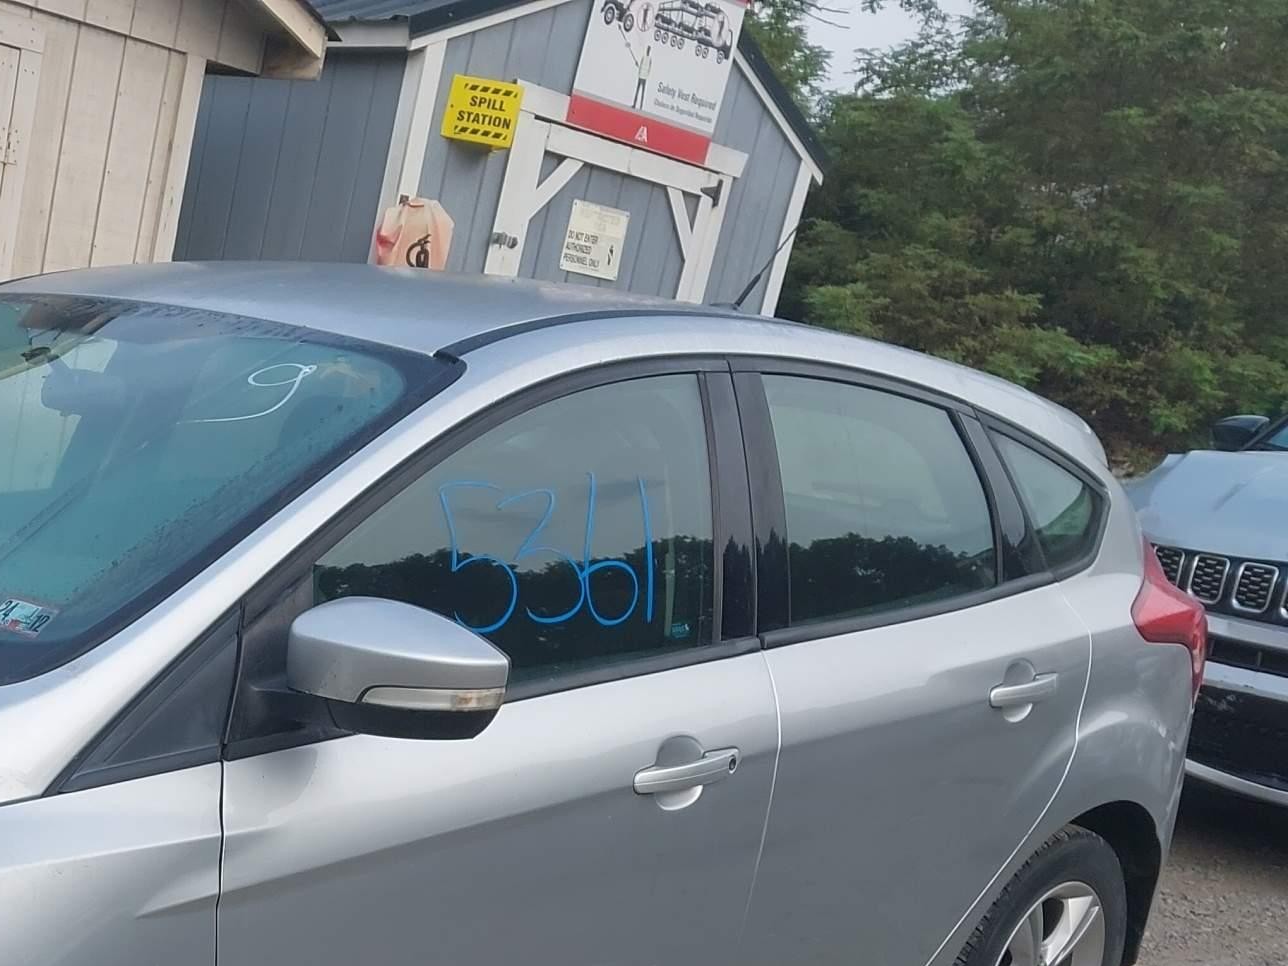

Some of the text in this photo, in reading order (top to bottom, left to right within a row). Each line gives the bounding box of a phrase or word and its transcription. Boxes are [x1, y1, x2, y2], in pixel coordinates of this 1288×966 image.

[469, 95, 506, 112] SPILL
[457, 110, 512, 130] STATION
[568, 230, 599, 245] DO NOT ENTER
[565, 242, 592, 255] AUTHORIZED
[563, 253, 600, 268] PERSONNEL ONLY
[439, 472, 654, 634] 5361
